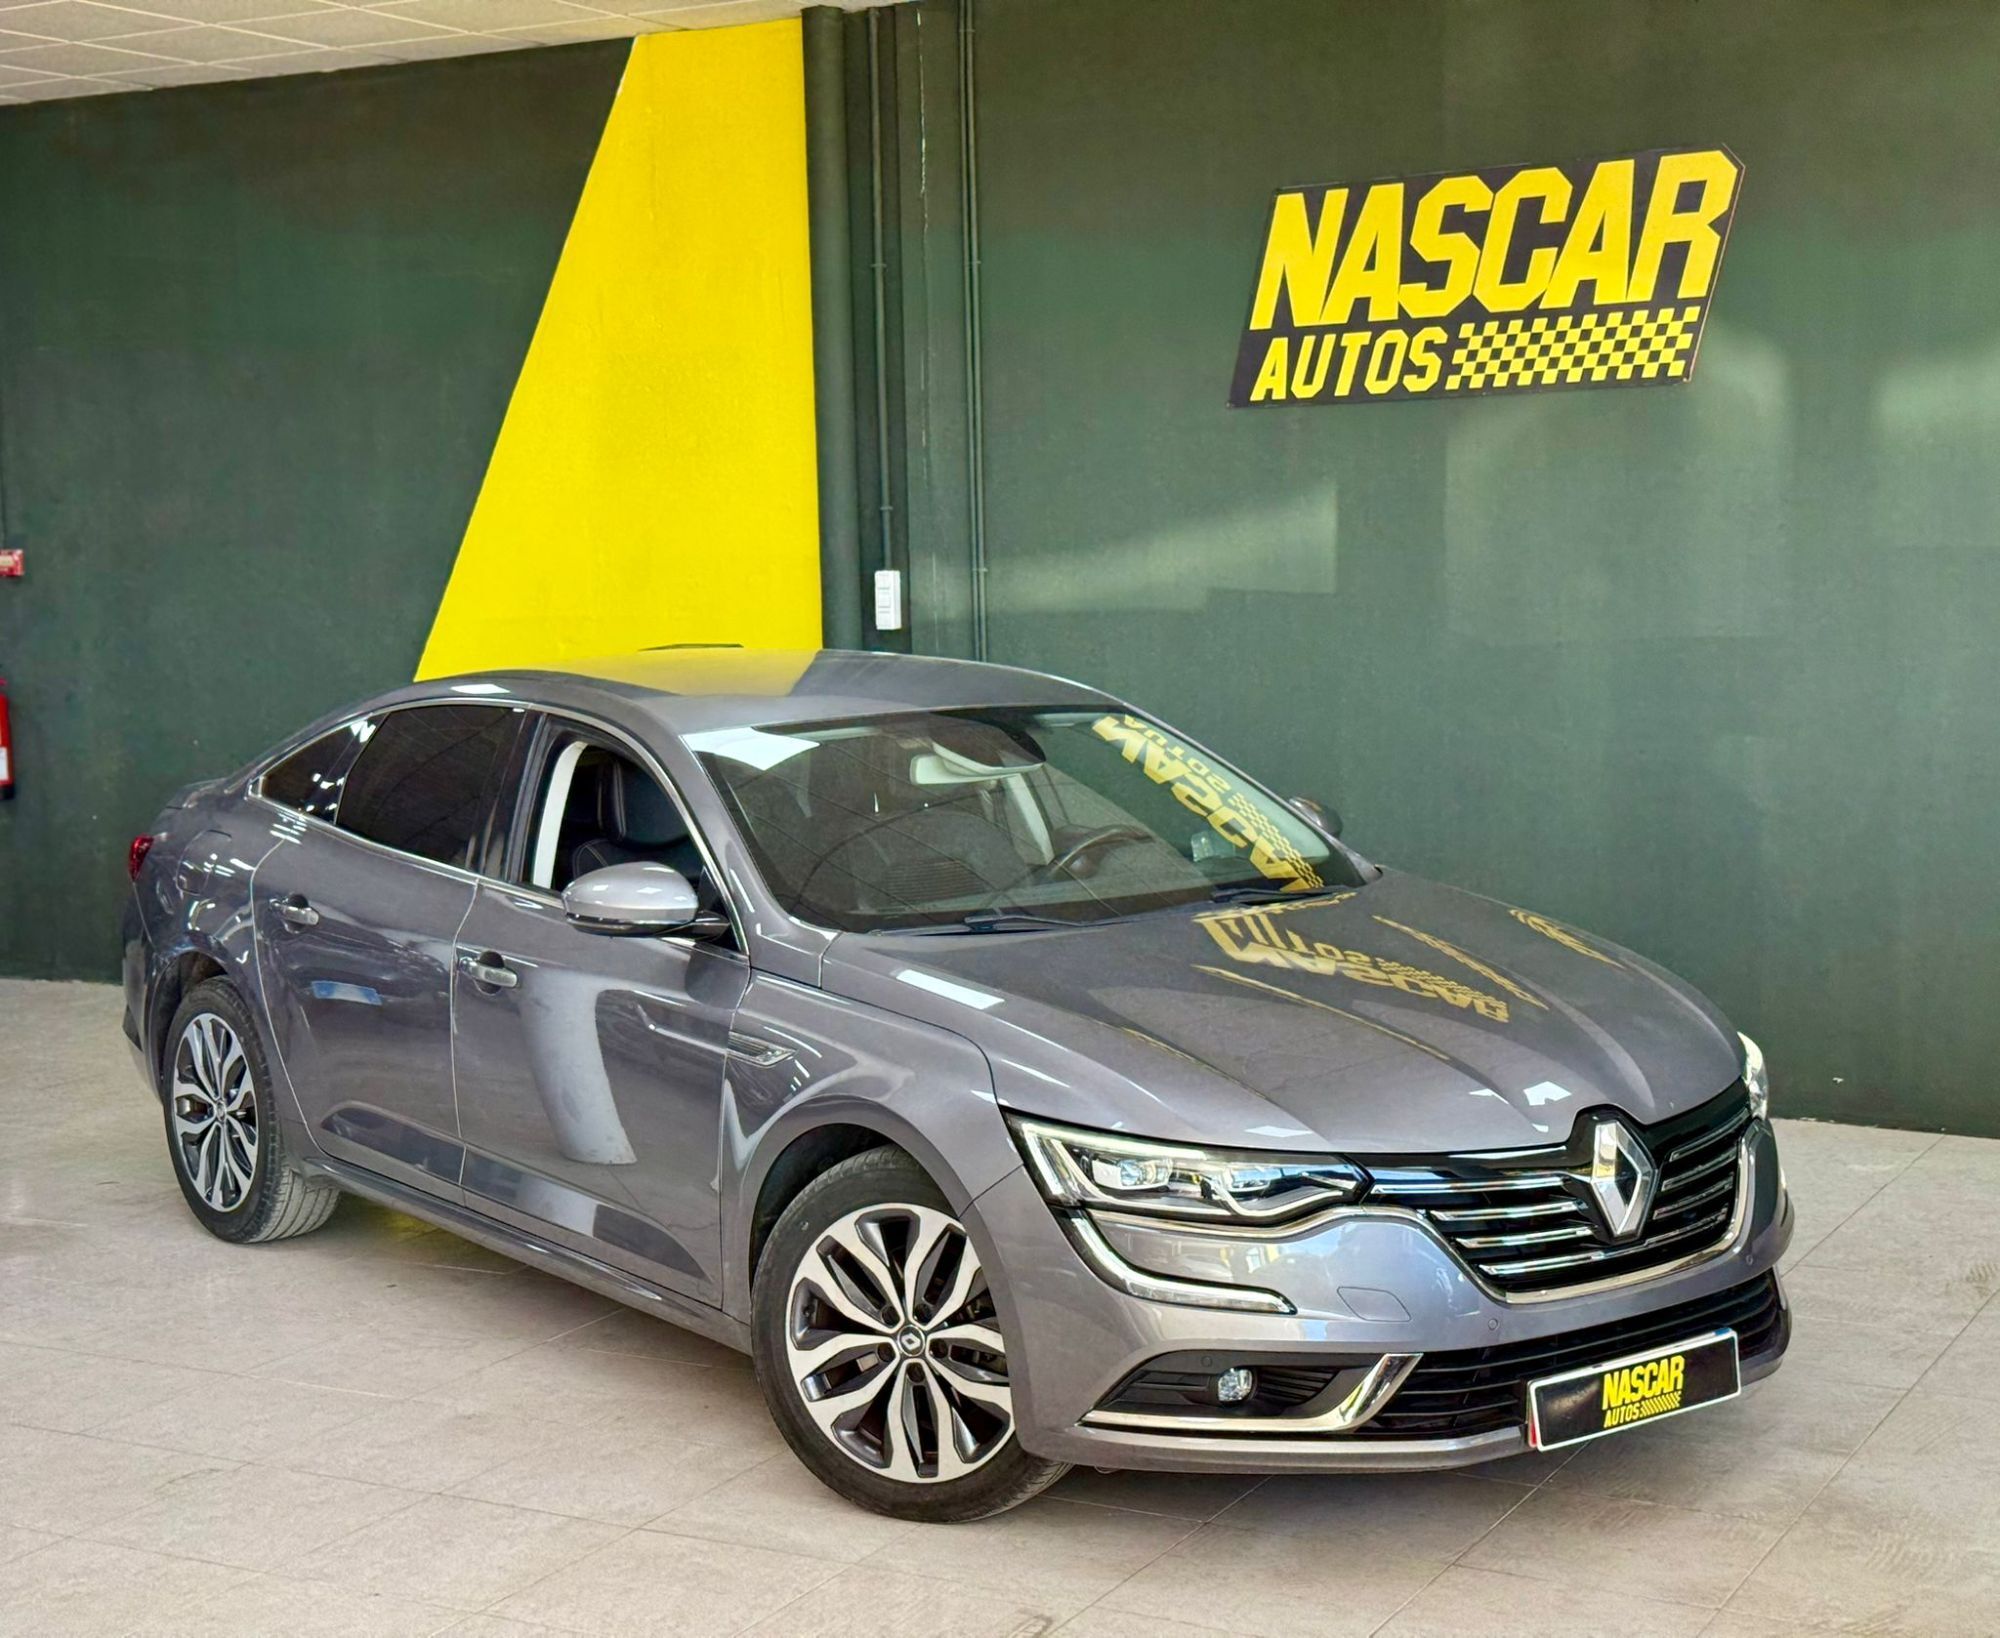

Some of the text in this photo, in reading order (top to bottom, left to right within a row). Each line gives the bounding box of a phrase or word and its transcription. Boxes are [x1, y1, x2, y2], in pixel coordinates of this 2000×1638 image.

[1249, 150, 1738, 330] NASCAR
[1250, 327, 1448, 401] AUTOS
[1602, 1355, 1685, 1410] NASCAR
[1603, 1402, 1640, 1428] AUTOS
